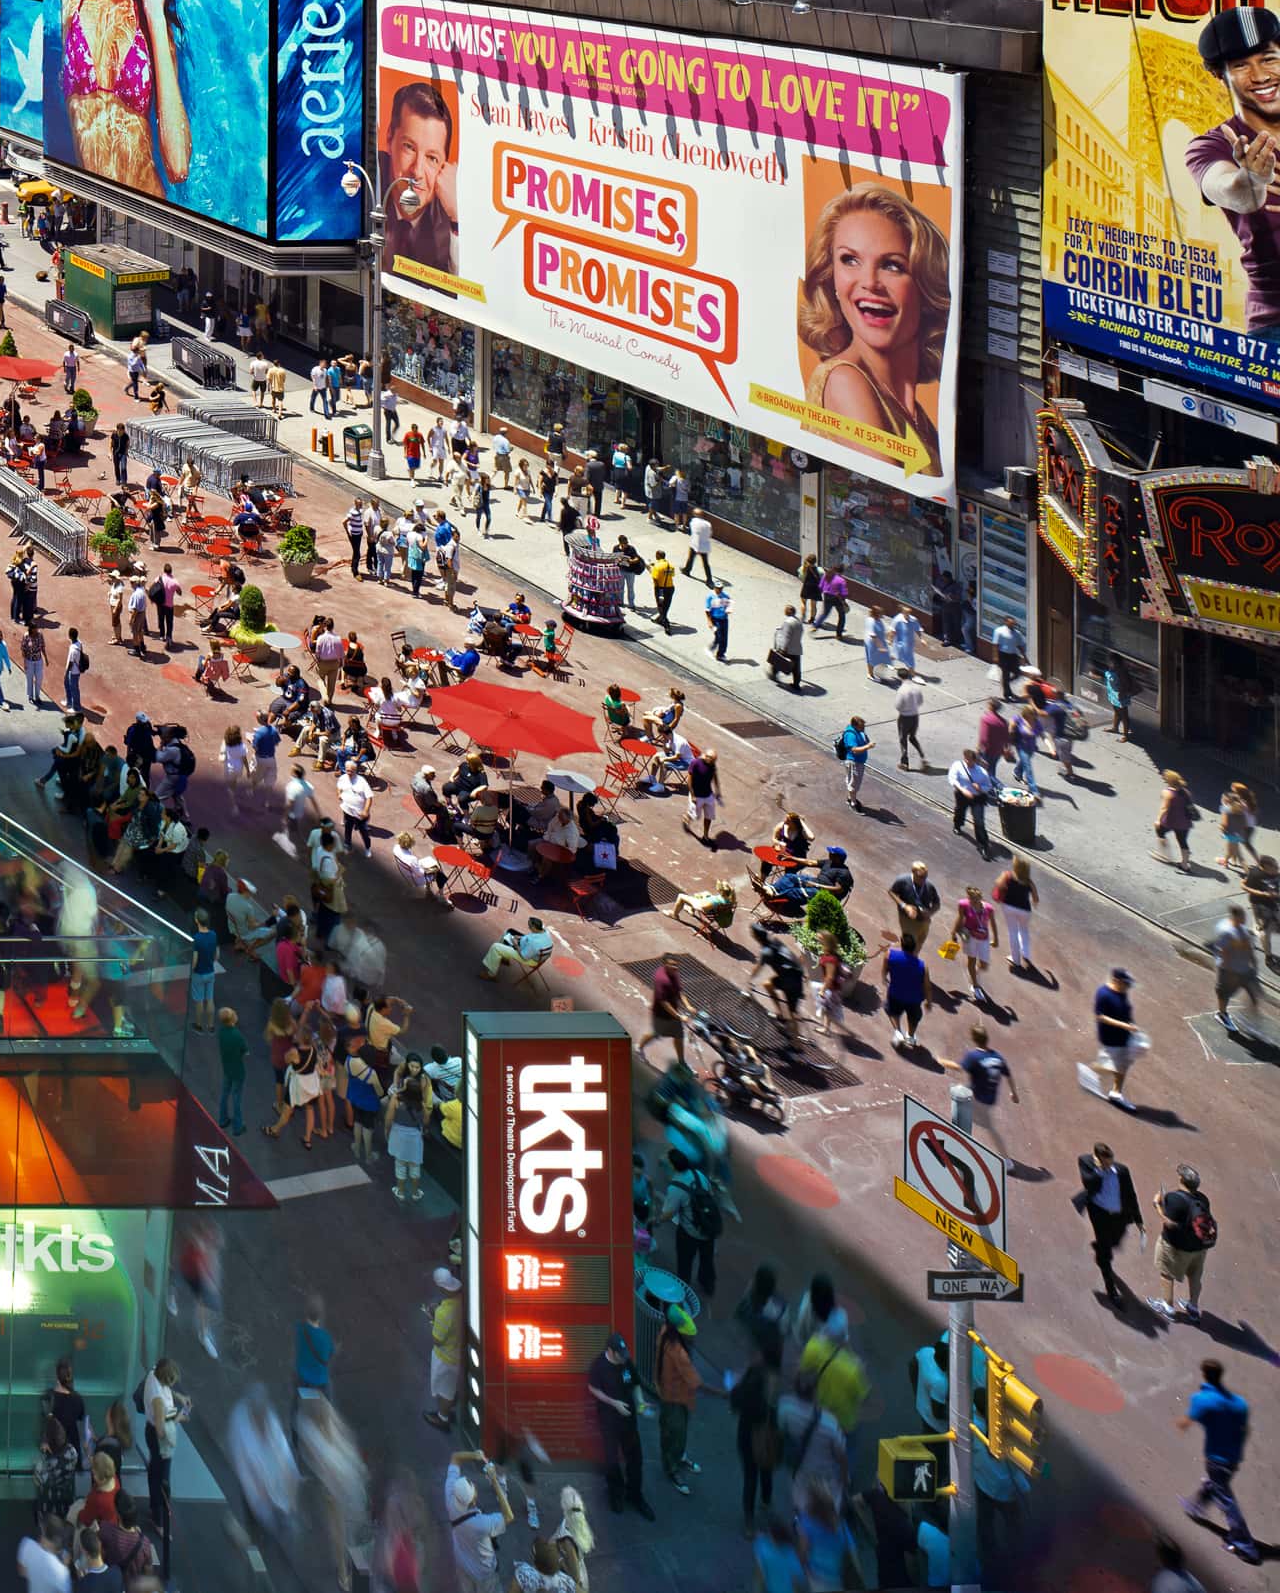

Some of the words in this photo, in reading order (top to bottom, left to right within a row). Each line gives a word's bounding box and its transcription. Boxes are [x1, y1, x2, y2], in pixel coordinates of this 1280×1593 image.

[301, 0, 345, 159] aerie
[414, 23, 506, 62] PROMISE
[619, 51, 703, 97] GOING
[762, 74, 844, 121] LOVE
[470, 94, 512, 127] Sean
[517, 102, 571, 137] Hayes
[588, 121, 654, 157] Kristin
[661, 131, 786, 186] Chenoweth
[506, 156, 687, 254] PROMISES,
[1068, 217, 1093, 236] TEXT
[1180, 243, 1217, 267] 21534
[1132, 248, 1185, 277] MESSAGE
[539, 243, 722, 344] PROMISES
[1063, 249, 1149, 306] CORBIN
[1158, 273, 1223, 324] BLEU
[1067, 288, 1216, 347] TICKETMASTER.COM
[543, 301, 567, 331] The
[567, 313, 622, 351] Musical
[625, 336, 682, 380] Comedy
[1098, 317, 1141, 339] RICHARD
[1143, 331, 1190, 354] RODGERS
[1193, 345, 1244, 372] THEATRE,
[763, 392, 807, 416] BROADWAY
[808, 407, 841, 430] THEATRE
[886, 438, 919, 459] STREET
[1200, 400, 1238, 428] CBS
[518, 1055, 608, 1236] tkts
[935, 1209, 974, 1248] NEW
[942, 1279, 969, 1293] ONE
[979, 1279, 1009, 1294] WAY
